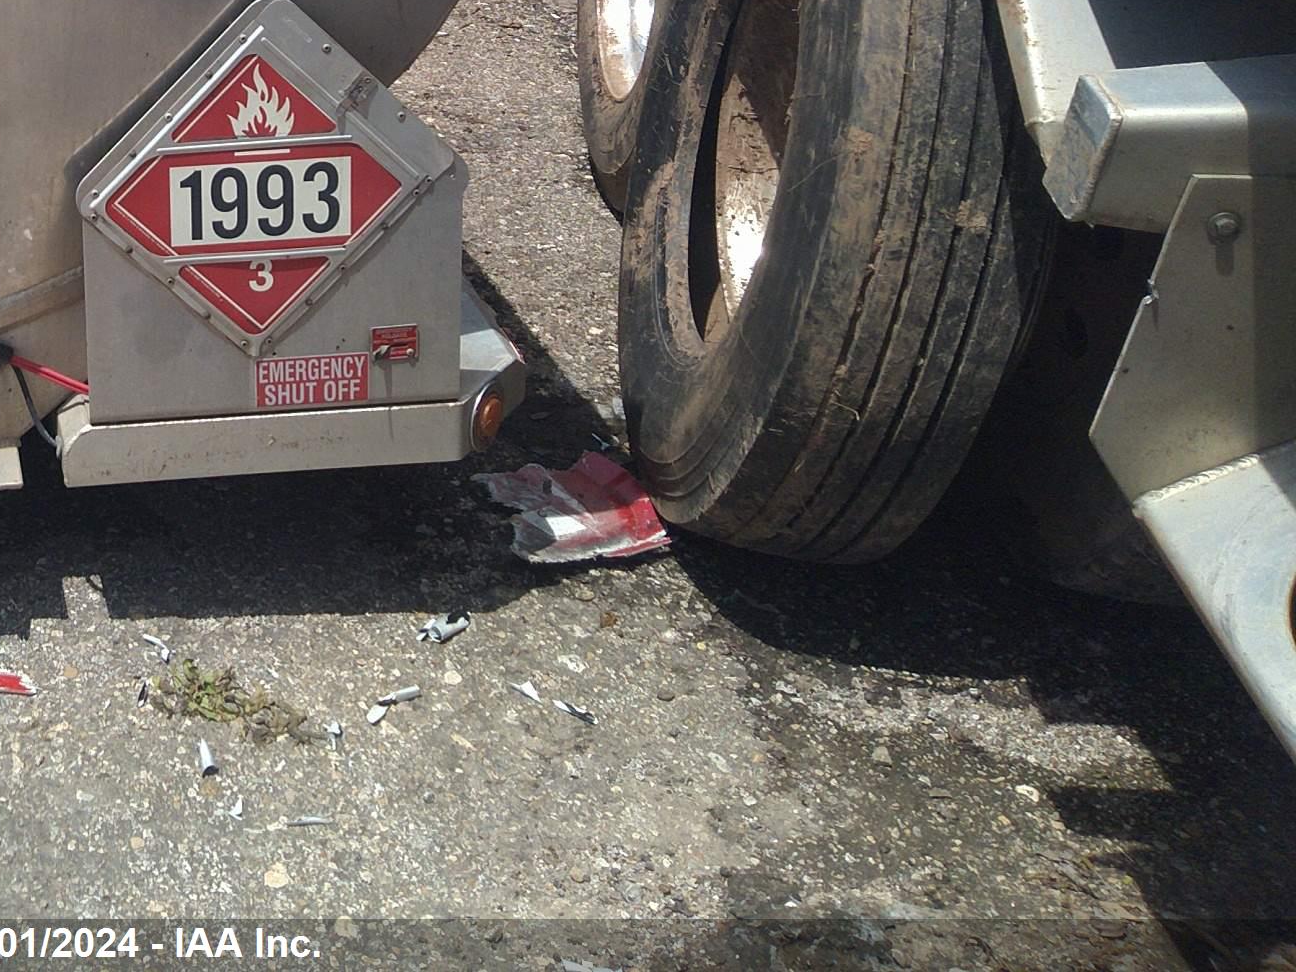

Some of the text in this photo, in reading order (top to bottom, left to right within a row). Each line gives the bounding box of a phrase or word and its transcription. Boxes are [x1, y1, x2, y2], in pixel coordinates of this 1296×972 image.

[179, 161, 341, 241] 1993
[248, 259, 274, 292] 3
[258, 355, 366, 384] EMERGENCY
[264, 379, 361, 406] SHUT OFF
